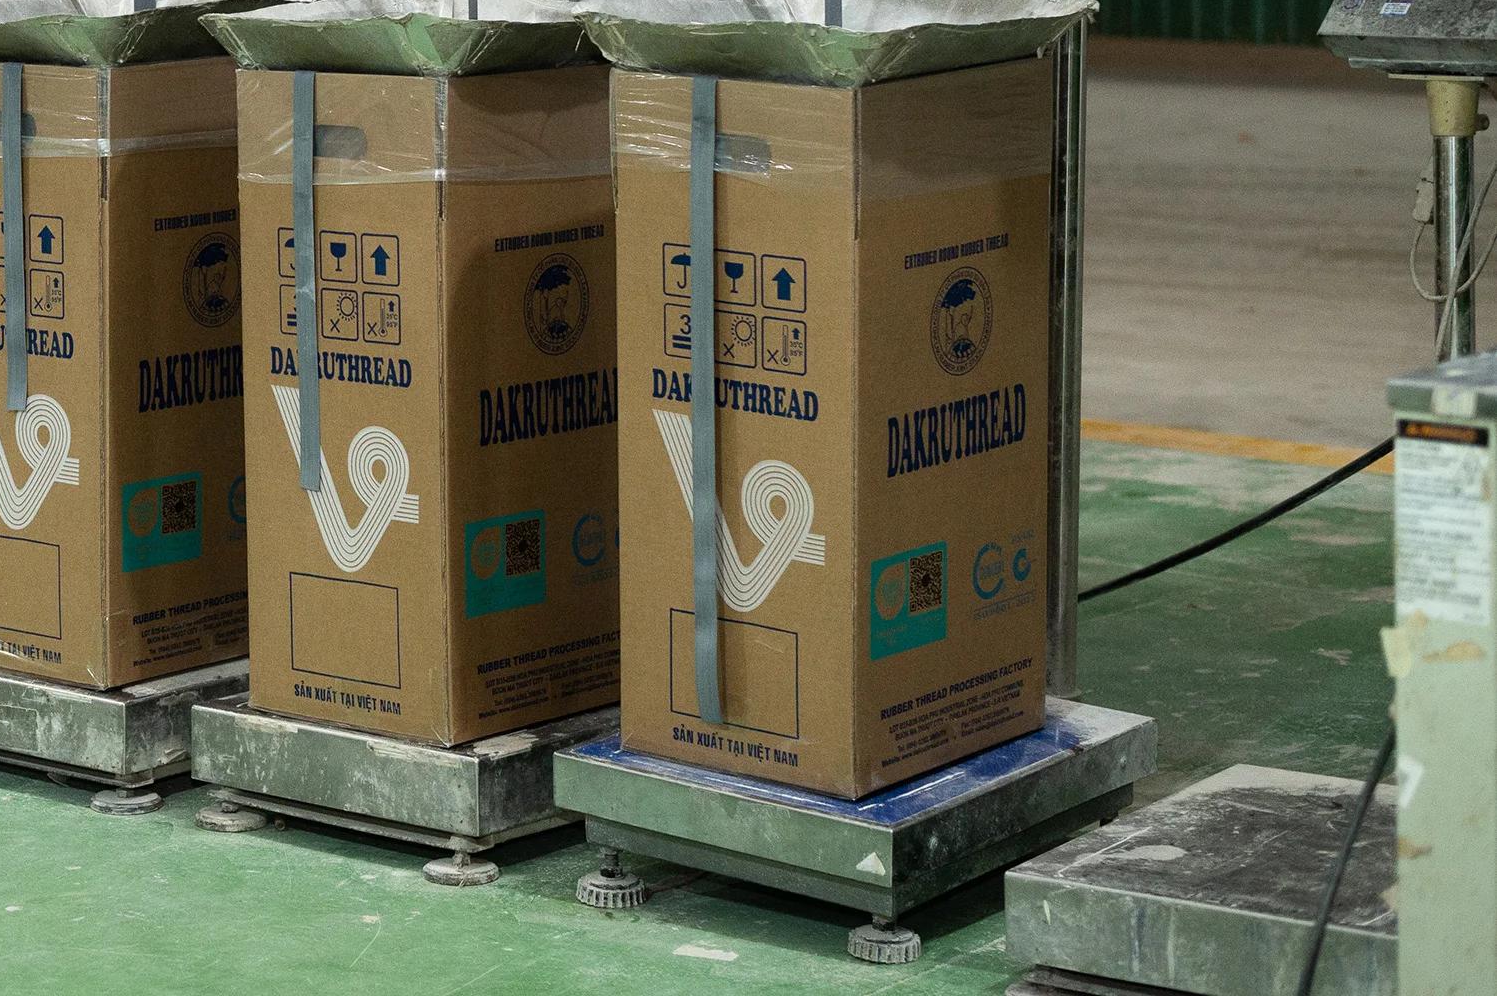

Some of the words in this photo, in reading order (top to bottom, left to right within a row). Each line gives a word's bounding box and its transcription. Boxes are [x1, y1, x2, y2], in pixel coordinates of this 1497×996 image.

[679, 314, 691, 335] 3
[887, 383, 1026, 478] DAKRUTHREAD
[133, 608, 166, 625] RUBBER
[477, 656, 511, 675] RUBBER
[513, 648, 547, 667] THREAD
[294, 680, 312, 699] SẢN
[314, 686, 337, 704] XUẤT
[340, 692, 355, 709] TẠI
[357, 694, 377, 713] VIỆT
[379, 699, 402, 715] NAM
[880, 700, 913, 720] RUBBER
[916, 687, 948, 708] THREAD
[949, 669, 998, 696] PROCESSING
[999, 657, 1033, 678] FACTORY
[672, 723, 694, 744] SẢN
[697, 731, 724, 751] XUẤT
[726, 738, 744, 757] TẠI
[747, 742, 771, 763] VIỆT
[773, 749, 798, 767] NAM
